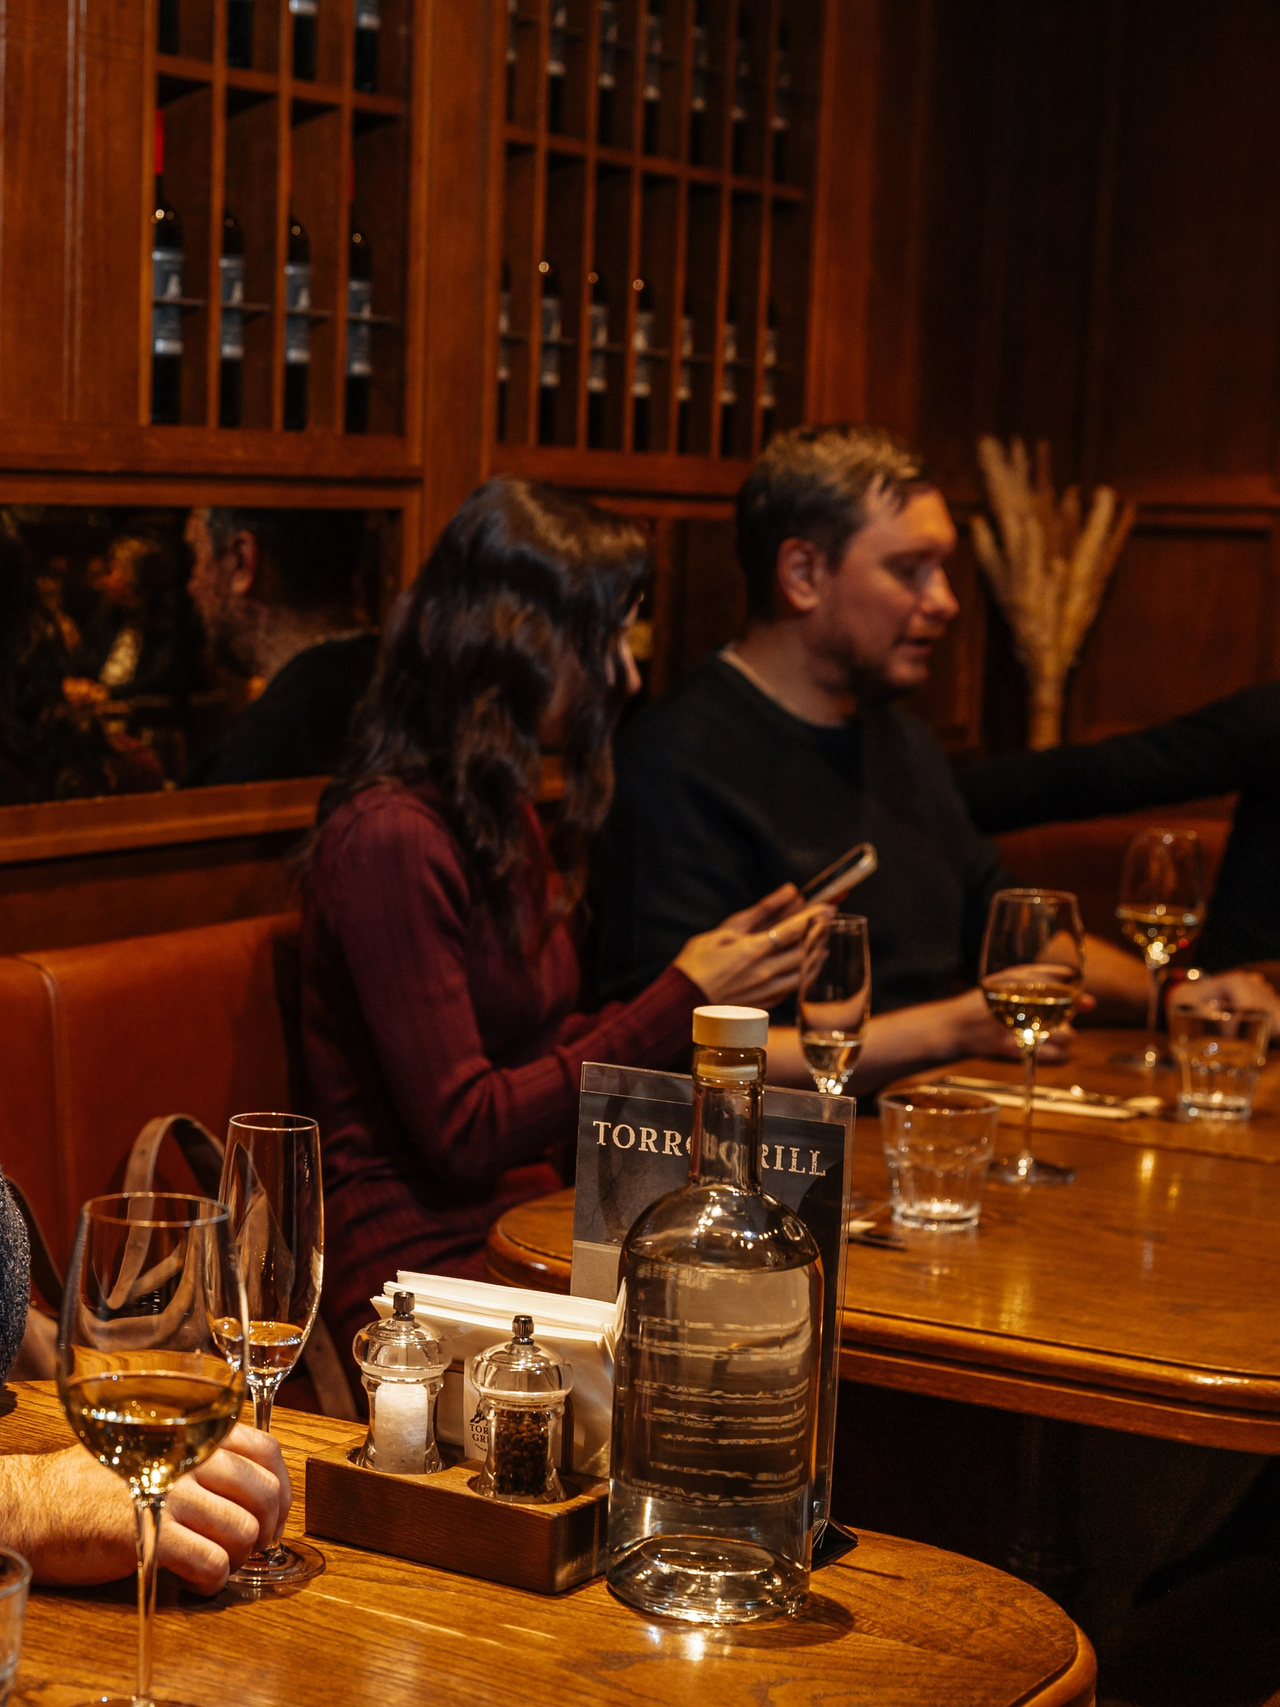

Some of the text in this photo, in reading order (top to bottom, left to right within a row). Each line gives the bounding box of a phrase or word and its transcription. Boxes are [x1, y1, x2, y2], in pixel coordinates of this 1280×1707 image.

[592, 1120, 692, 1157] TORR
[469, 1423, 489, 1434] TOR
[471, 1433, 489, 1444] GRI
